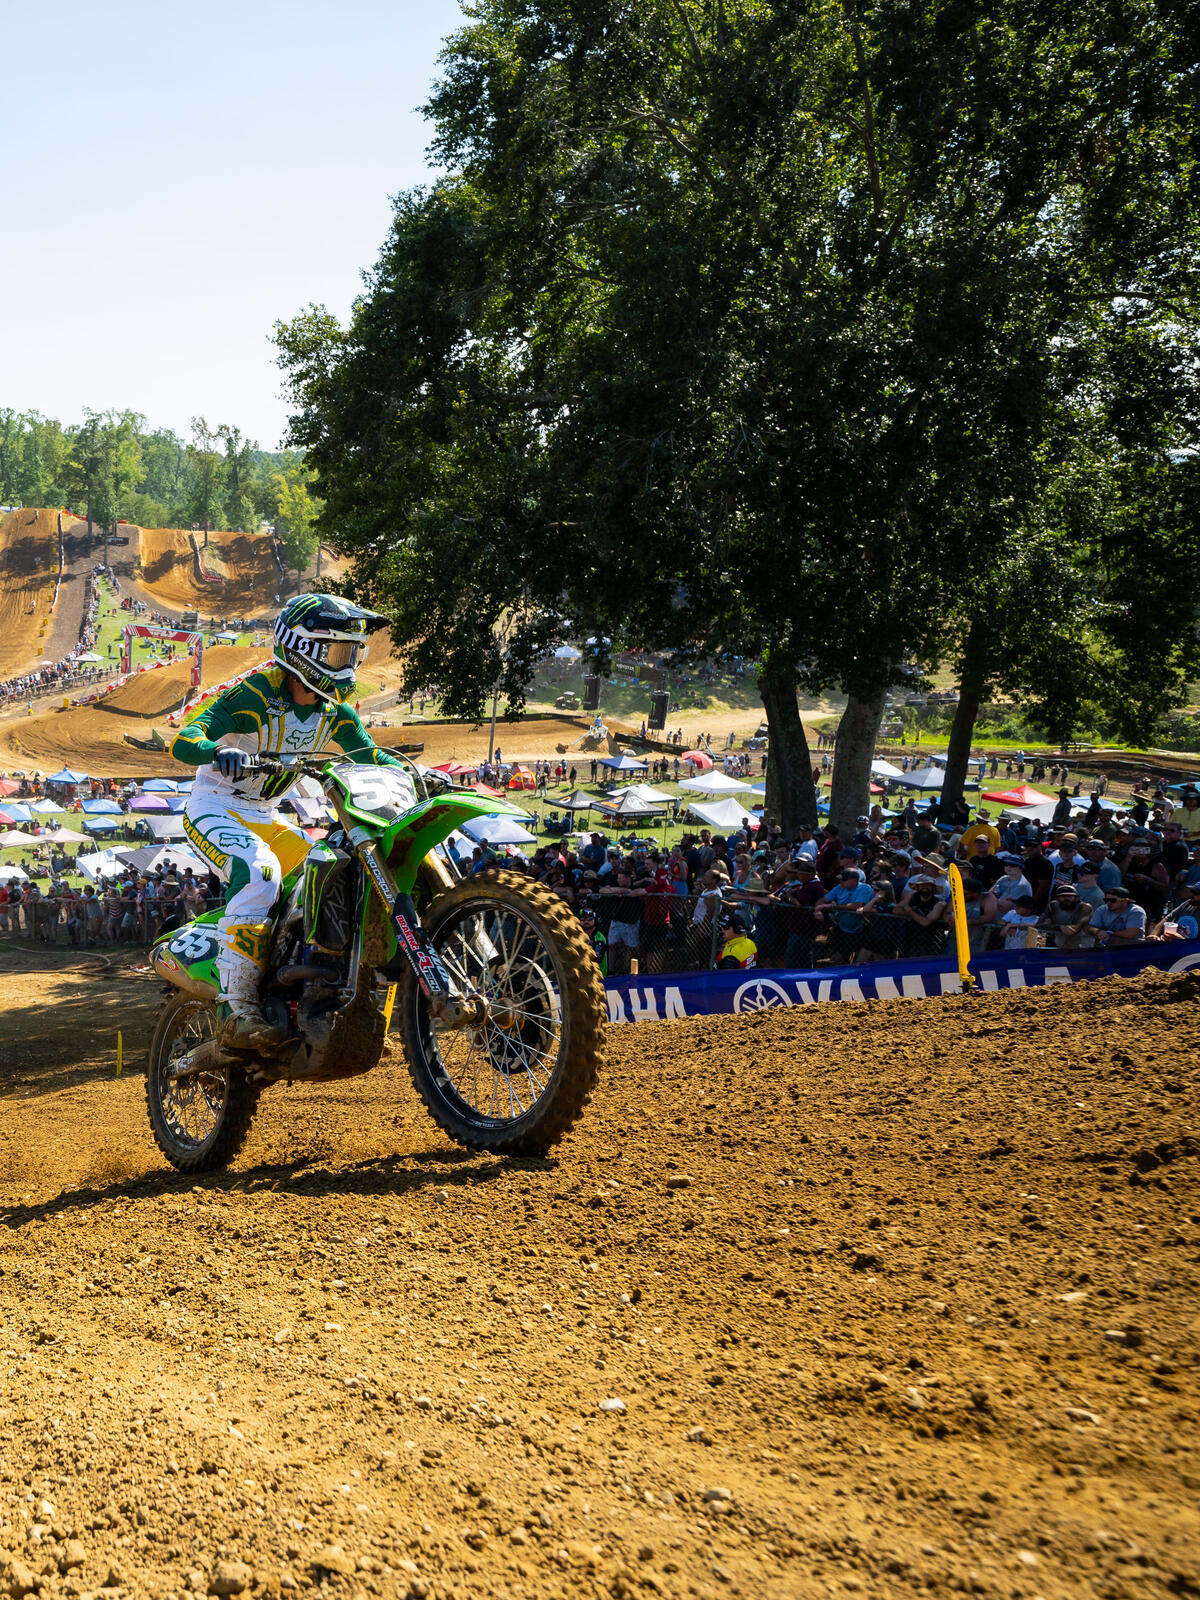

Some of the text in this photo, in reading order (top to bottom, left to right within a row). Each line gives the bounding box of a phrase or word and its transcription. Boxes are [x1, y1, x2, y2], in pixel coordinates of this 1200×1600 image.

[362, 849, 378, 869] PRO
[373, 867, 396, 904] CIRCUIT
[170, 929, 216, 959] 55
[396, 914, 420, 951] BRAKING
[606, 986, 687, 1023] AHA
